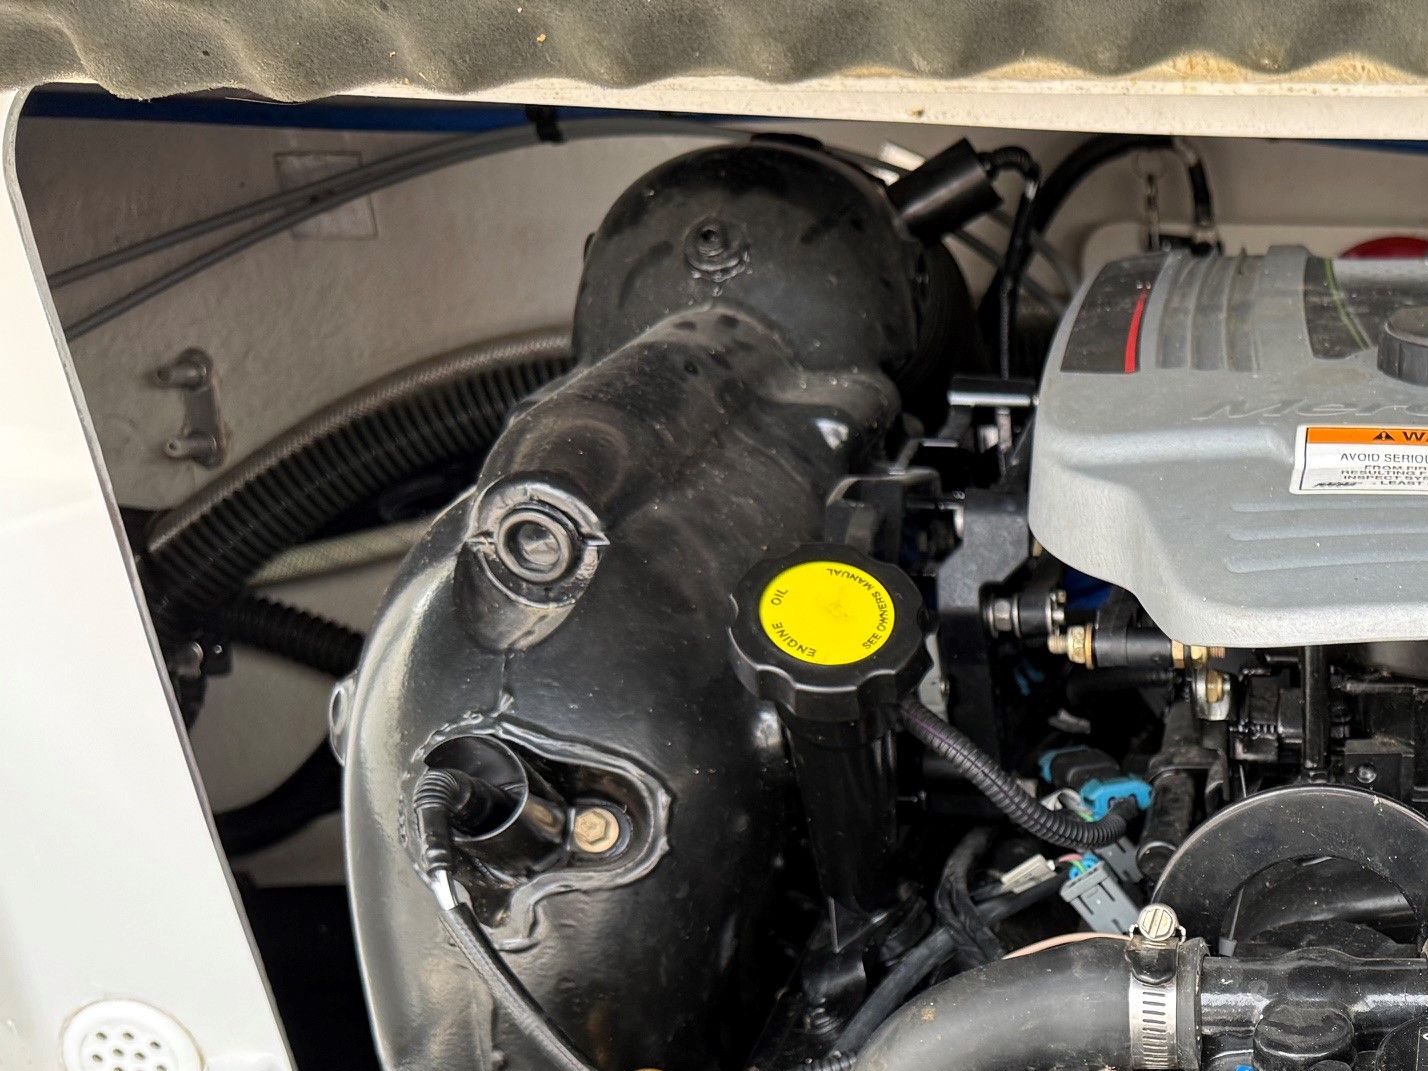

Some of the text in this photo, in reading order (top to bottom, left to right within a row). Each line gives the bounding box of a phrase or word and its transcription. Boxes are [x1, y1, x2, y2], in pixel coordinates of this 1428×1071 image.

[1341, 453, 1380, 462] AVOID
[771, 588, 789, 606] OIL
[827, 568, 889, 650] SEE OWNERS MANUAL
[772, 622, 816, 657] ENGINE
